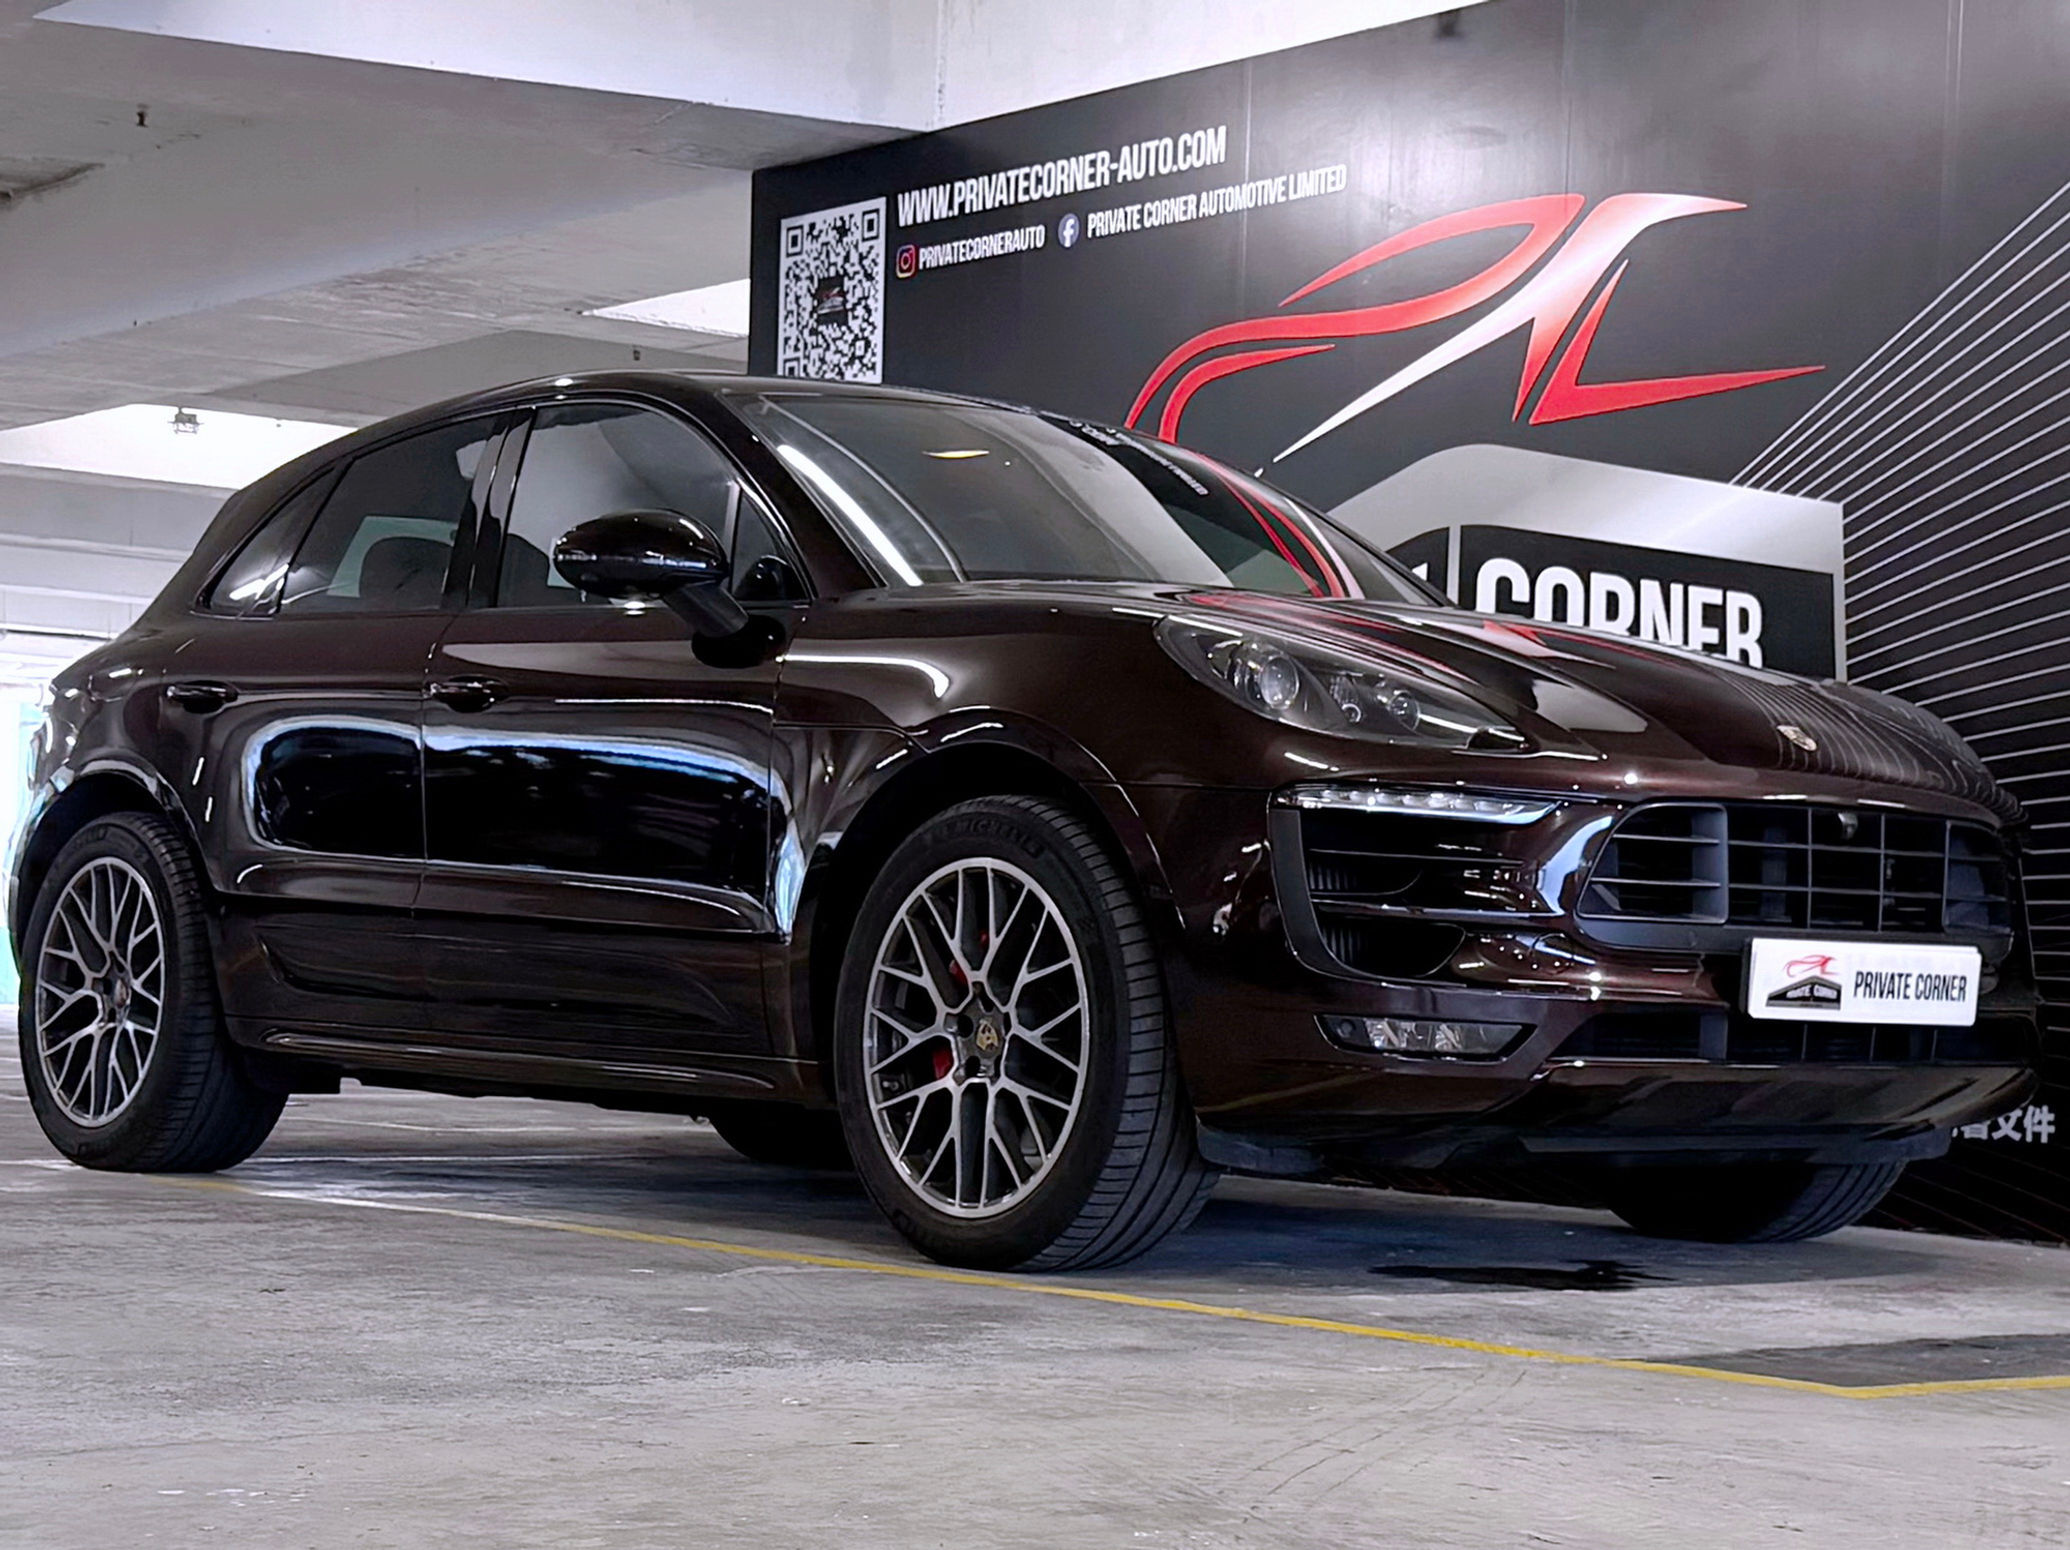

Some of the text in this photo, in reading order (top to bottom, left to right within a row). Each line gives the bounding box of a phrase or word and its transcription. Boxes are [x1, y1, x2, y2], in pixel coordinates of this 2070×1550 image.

[897, 125, 1227, 228] WWW.PRIVATECORNER-AUTO.COM
[1087, 164, 1347, 239] PRIVATE CORNER AUTOMOTIVE LIMITED
[918, 224, 1046, 270] PRIVATECORNERAUTO
[1853, 971, 1912, 1001] PRIVATE
[1914, 974, 1968, 1002] CORNER
